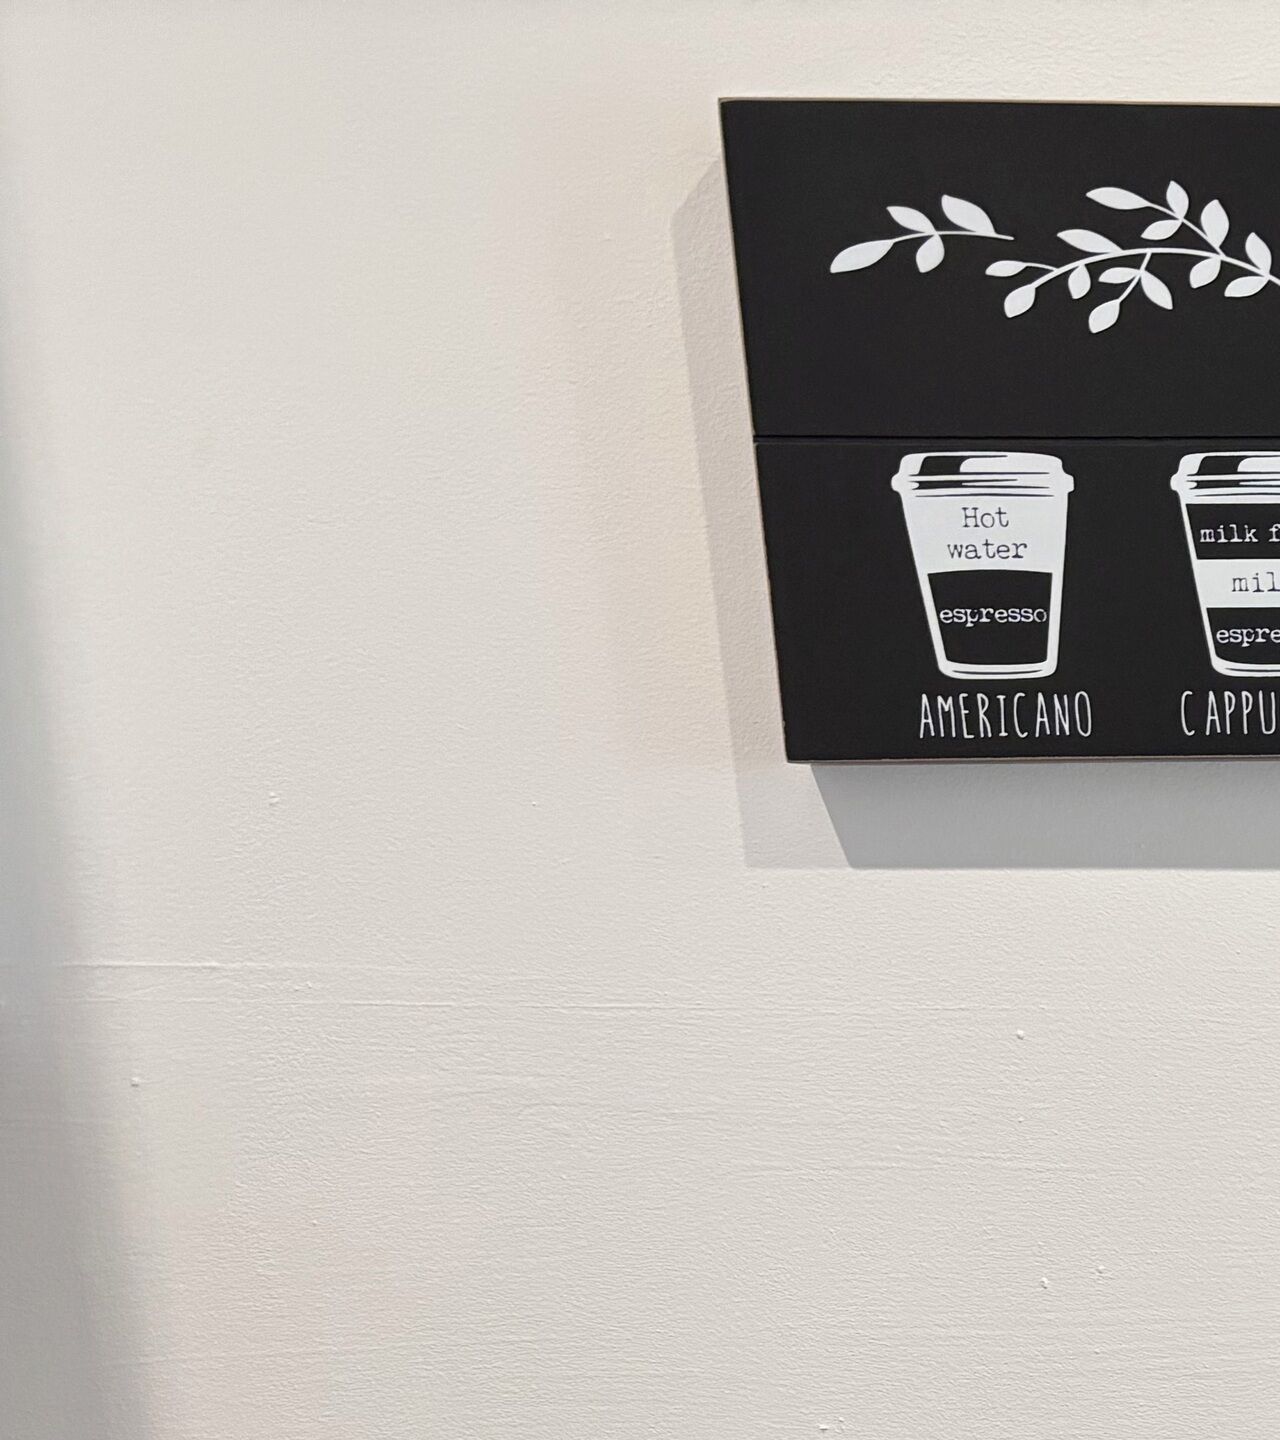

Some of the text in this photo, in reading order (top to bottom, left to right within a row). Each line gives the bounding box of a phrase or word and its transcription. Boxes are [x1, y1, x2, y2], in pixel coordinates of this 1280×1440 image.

[961, 507, 1010, 529] Hot
[1200, 523, 1259, 544] milk
[947, 541, 1028, 560] water
[939, 607, 1048, 628] espresso
[918, 690, 1093, 740] AMERICANO
